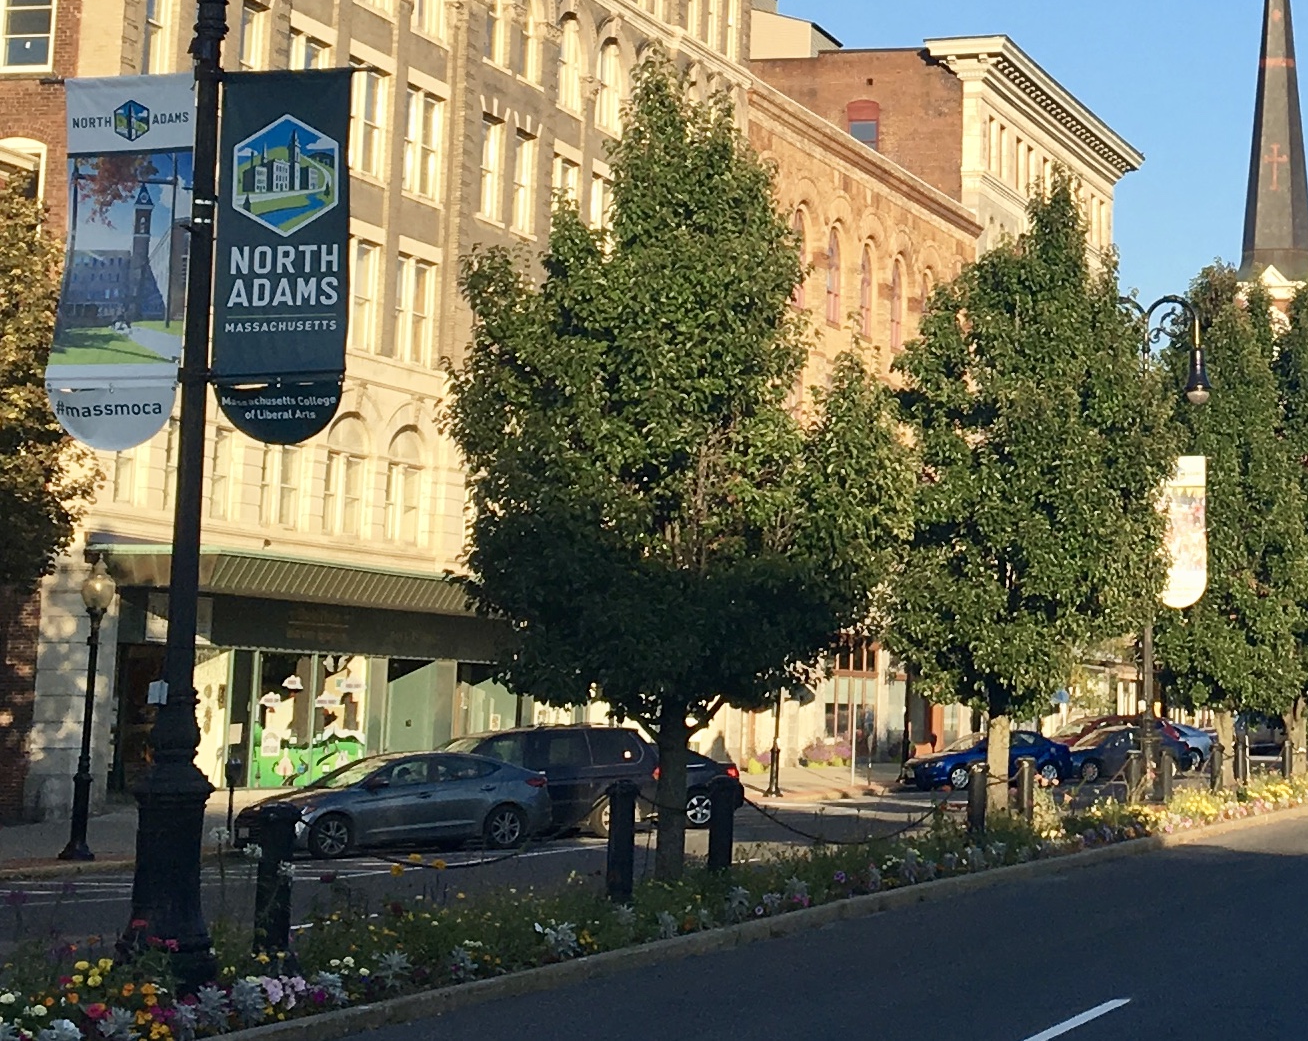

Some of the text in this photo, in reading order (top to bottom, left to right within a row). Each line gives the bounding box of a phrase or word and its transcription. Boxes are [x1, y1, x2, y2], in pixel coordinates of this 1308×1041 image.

[72, 111, 189, 129] NORTH ADAMS
[230, 244, 339, 275] NORTH
[227, 276, 339, 307] ADAMS
[225, 320, 337, 333] MASSACHUSETTS
[56, 400, 162, 418] #massmoca
[297, 396, 337, 407] College
[244, 409, 316, 419] of Liberal Arts
